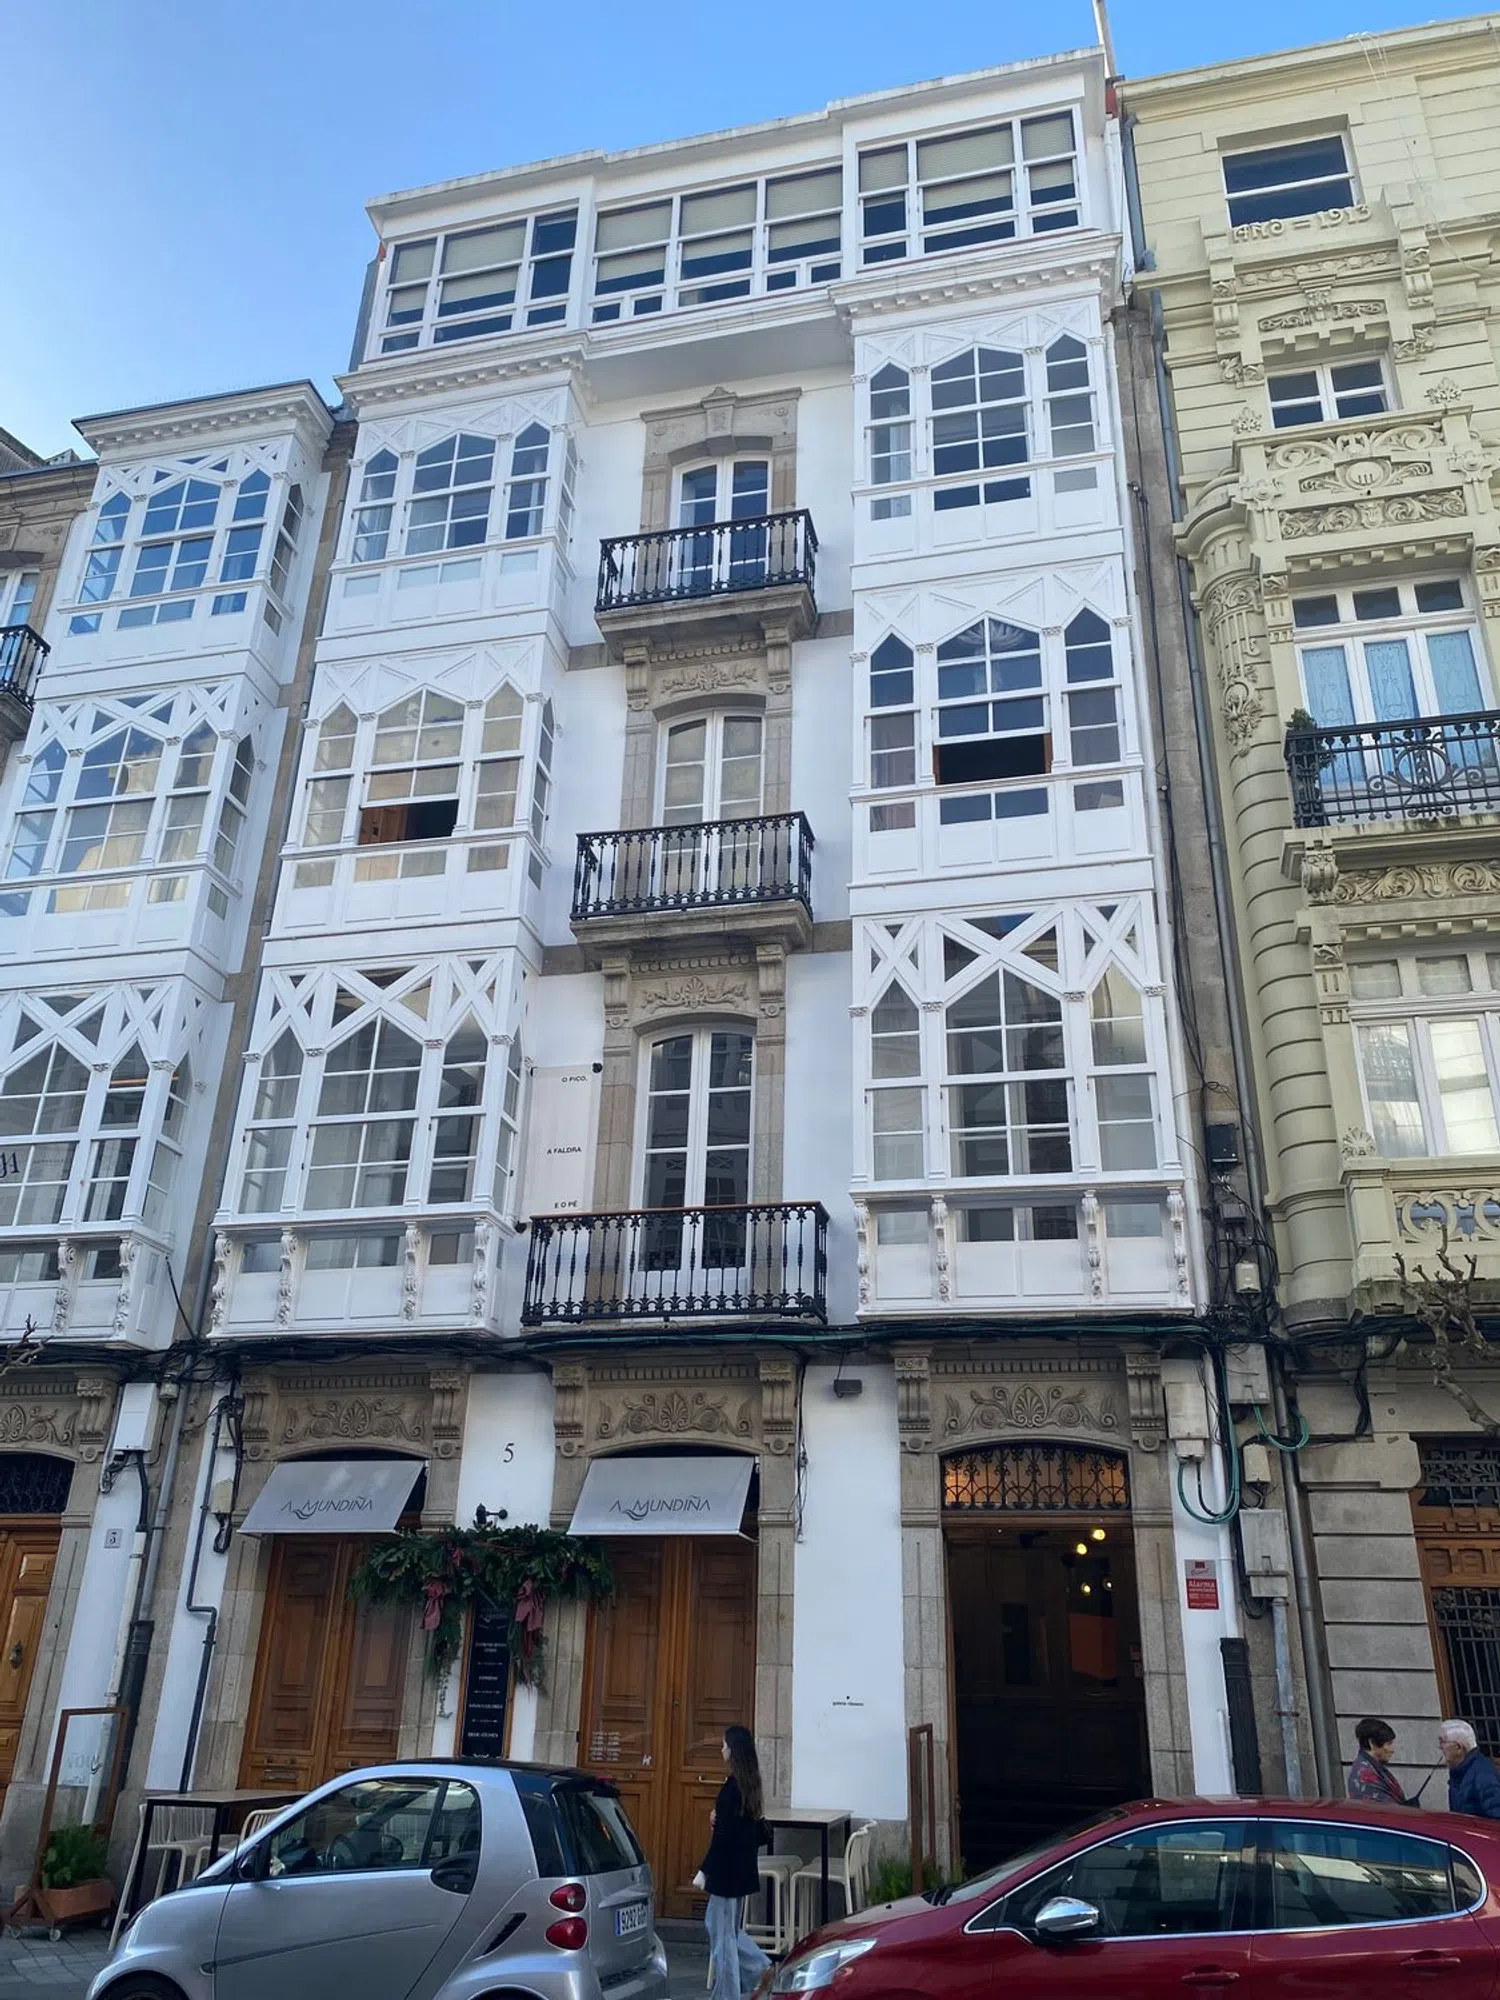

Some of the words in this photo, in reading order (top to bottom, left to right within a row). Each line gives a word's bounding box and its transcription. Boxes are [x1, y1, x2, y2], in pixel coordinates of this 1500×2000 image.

[1317, 203, 1371, 230] 1913
[503, 1442, 515, 1463] 5
[293, 1496, 373, 1520] MUNDIÑA
[622, 1495, 711, 1521] MUNDIÑA
